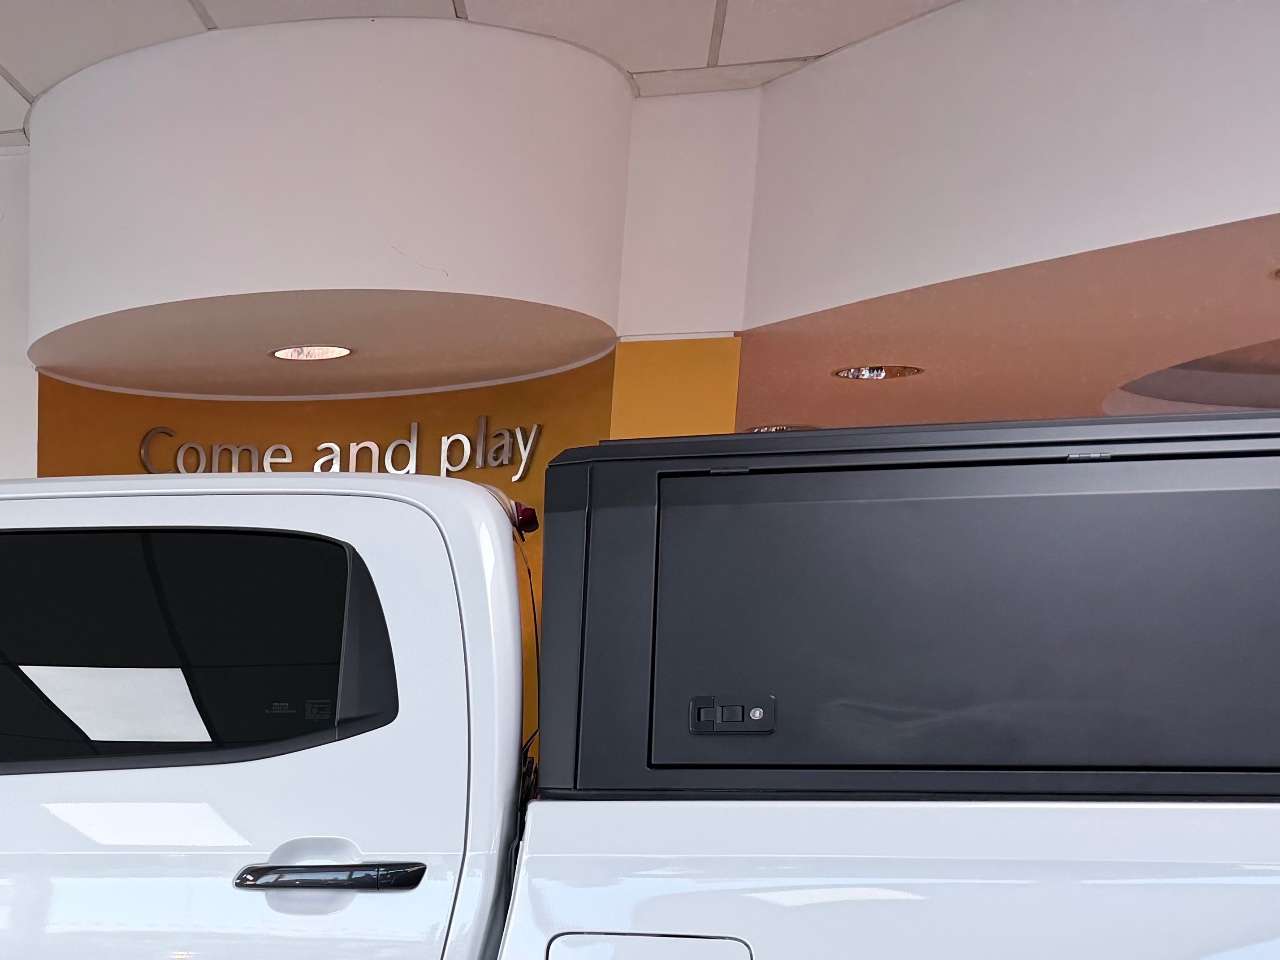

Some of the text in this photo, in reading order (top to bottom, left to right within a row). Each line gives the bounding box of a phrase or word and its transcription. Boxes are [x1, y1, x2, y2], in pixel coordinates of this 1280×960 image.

[140, 415, 542, 482] Come and play
